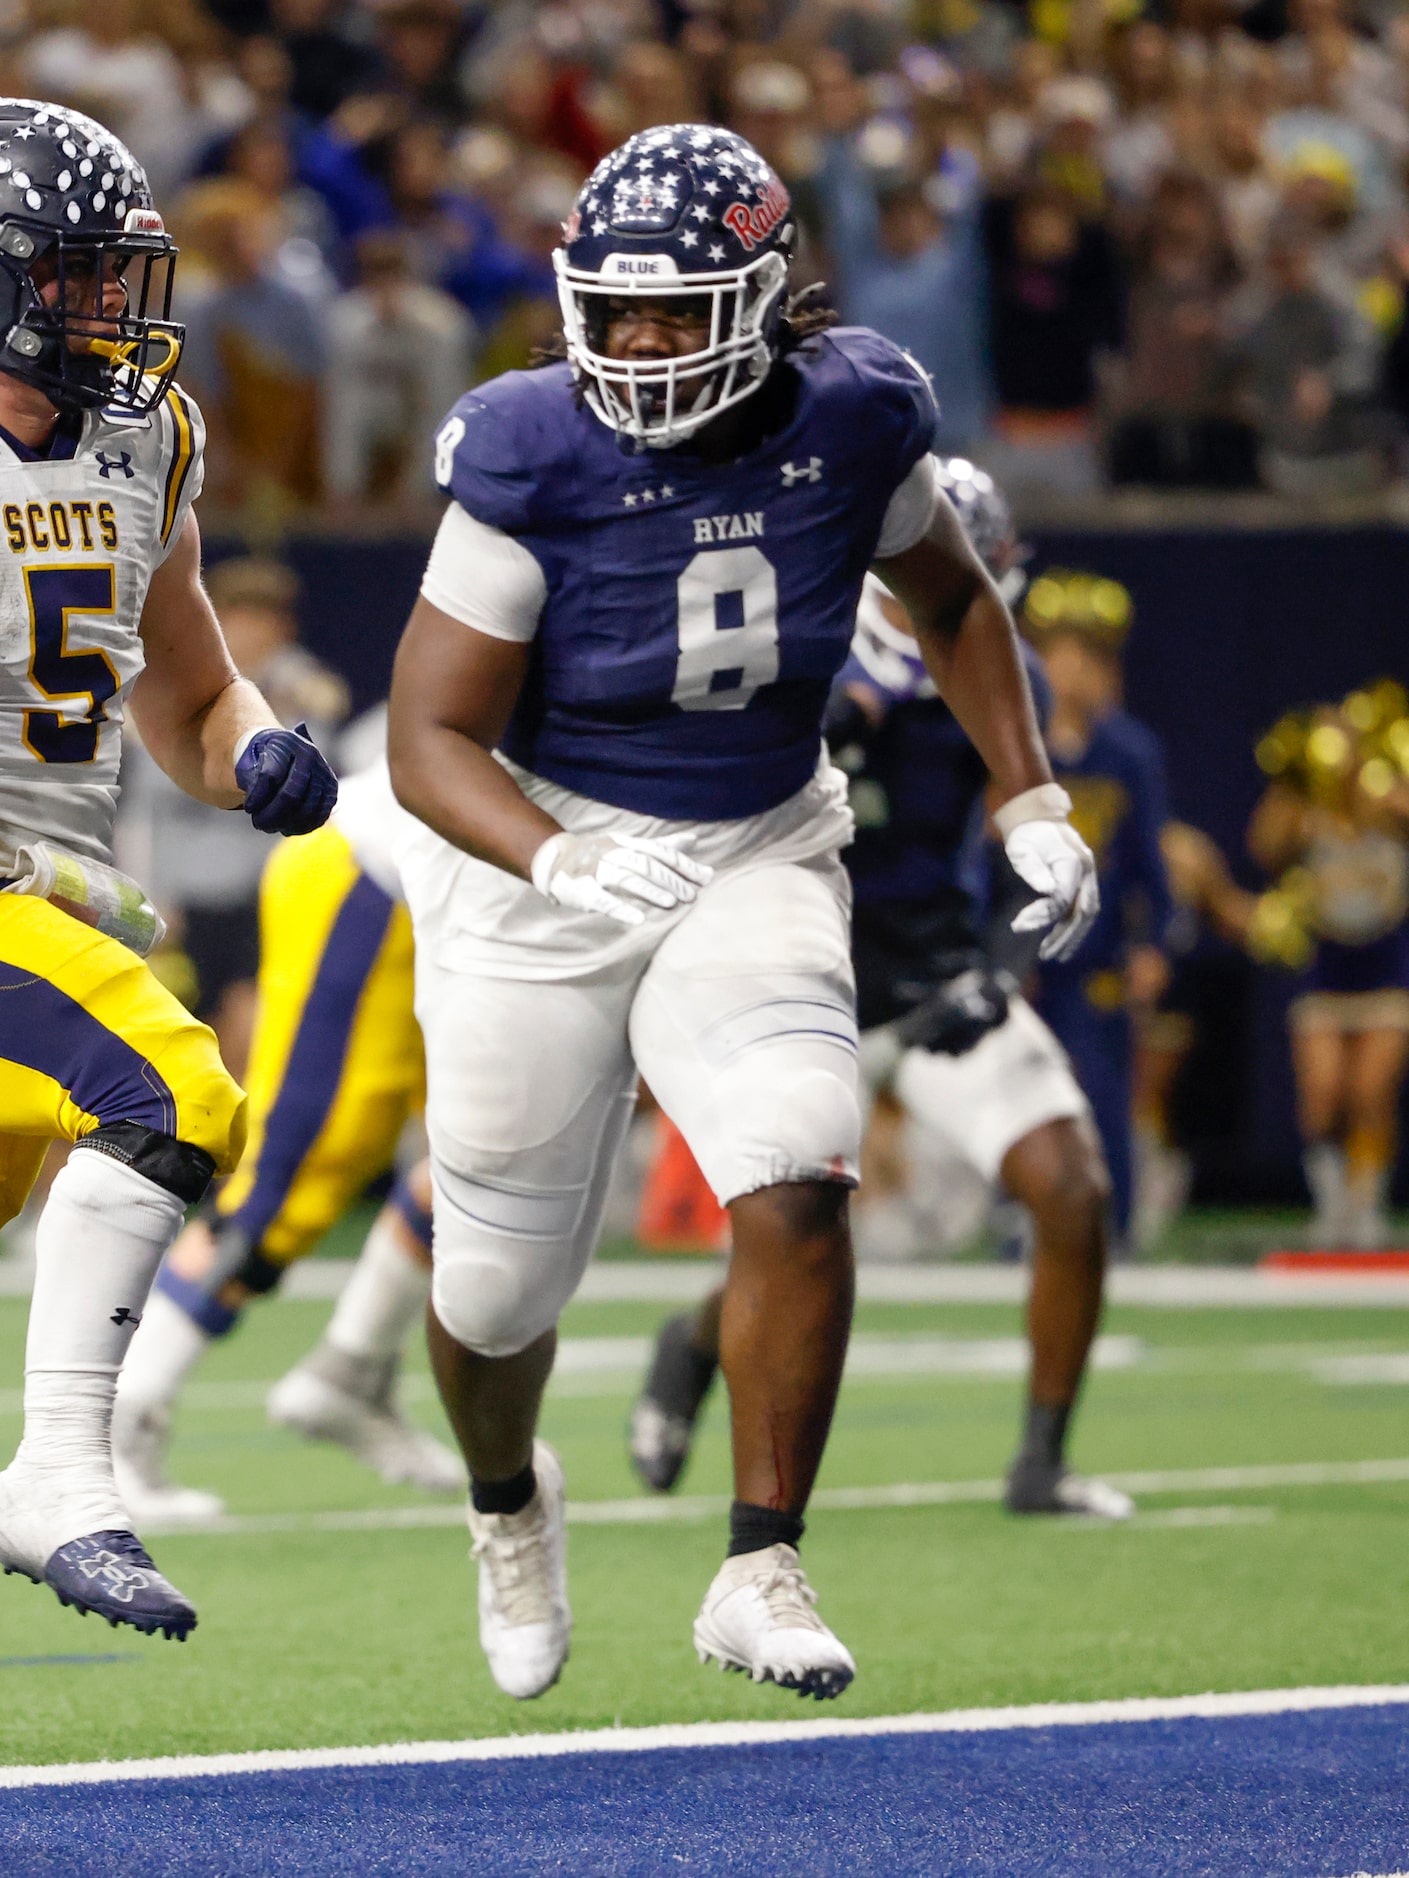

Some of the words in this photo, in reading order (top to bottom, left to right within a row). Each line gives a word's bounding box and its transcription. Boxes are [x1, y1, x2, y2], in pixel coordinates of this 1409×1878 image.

[617, 261, 659, 274] BLUE
[435, 415, 466, 487] 8
[2, 501, 119, 553] SCOTS
[693, 512, 765, 543] RYAN
[670, 545, 780, 711] 8
[21, 562, 122, 763] 5
